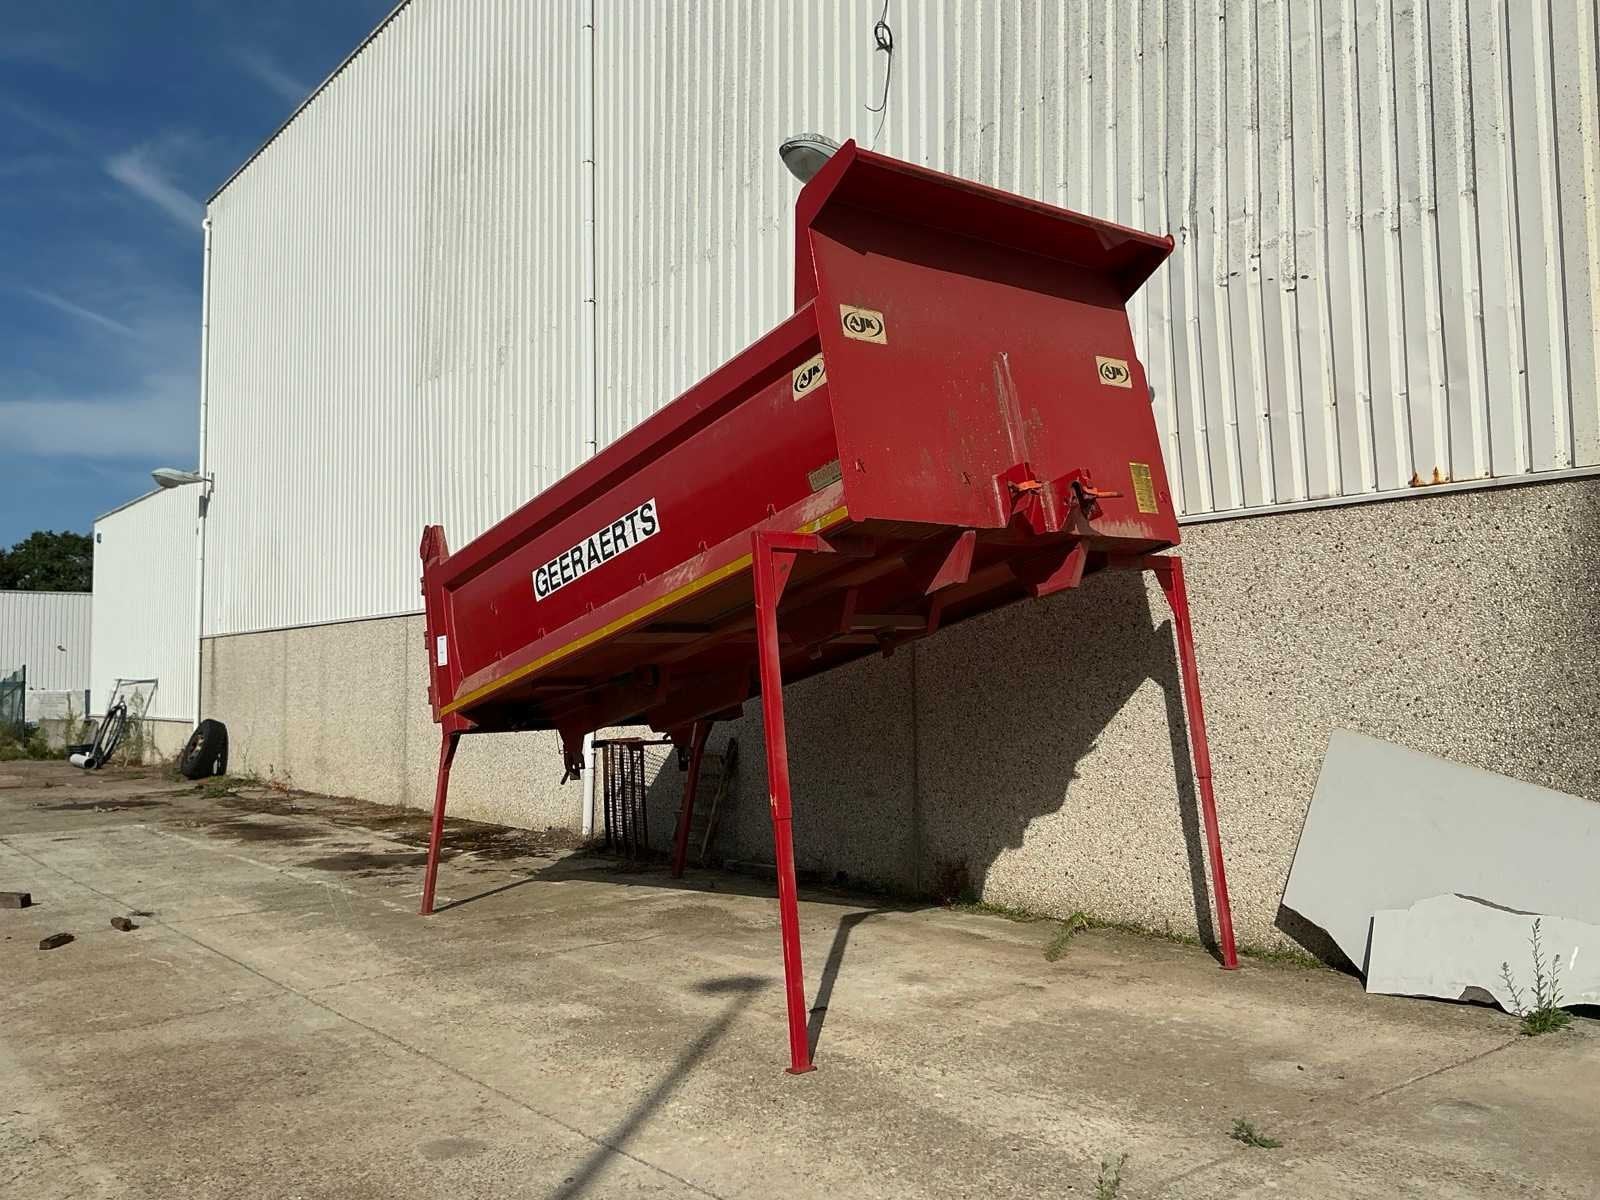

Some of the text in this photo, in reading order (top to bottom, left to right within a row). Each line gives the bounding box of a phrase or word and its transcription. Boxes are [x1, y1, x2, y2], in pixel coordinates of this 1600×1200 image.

[850, 316, 875, 333] AJK
[799, 364, 820, 388] AJK
[1104, 365, 1124, 380] AJK
[535, 503, 656, 597] GEERAERTS
